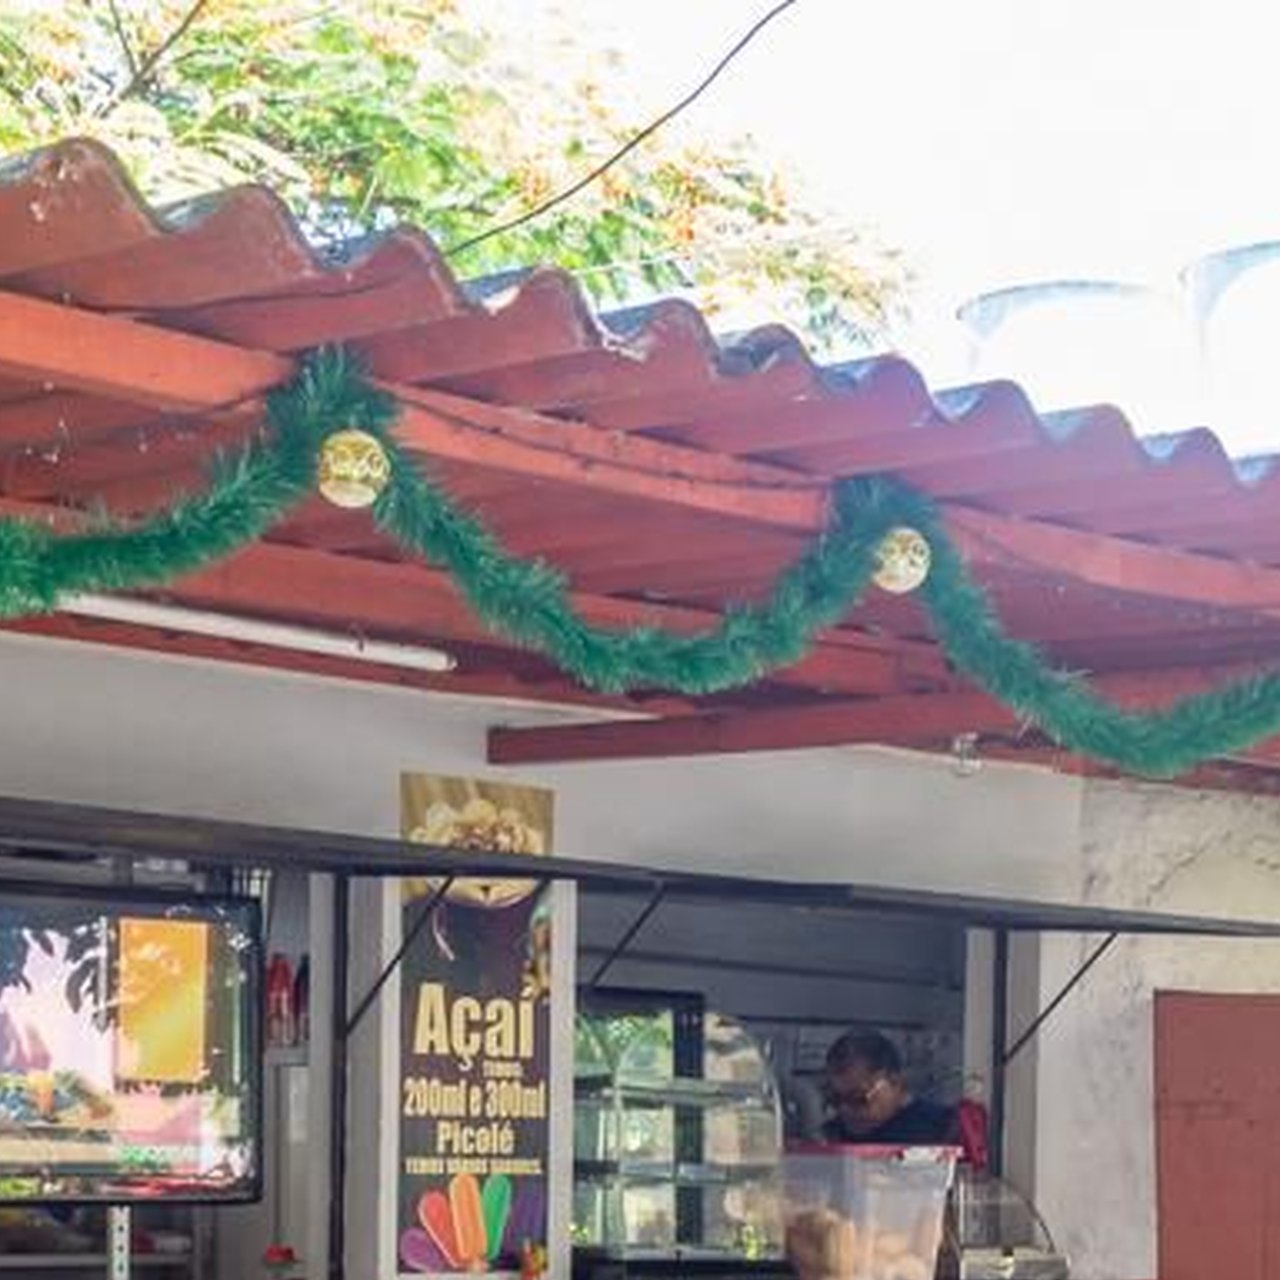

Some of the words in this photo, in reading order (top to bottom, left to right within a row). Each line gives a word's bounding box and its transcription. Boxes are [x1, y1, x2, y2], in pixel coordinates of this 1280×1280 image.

[414, 982, 535, 1071] Açaí
[404, 1077, 467, 1117] 200ml
[471, 1085, 482, 1117] e
[486, 1080, 546, 1118] 300ml
[437, 1120, 515, 1155] Picolé
